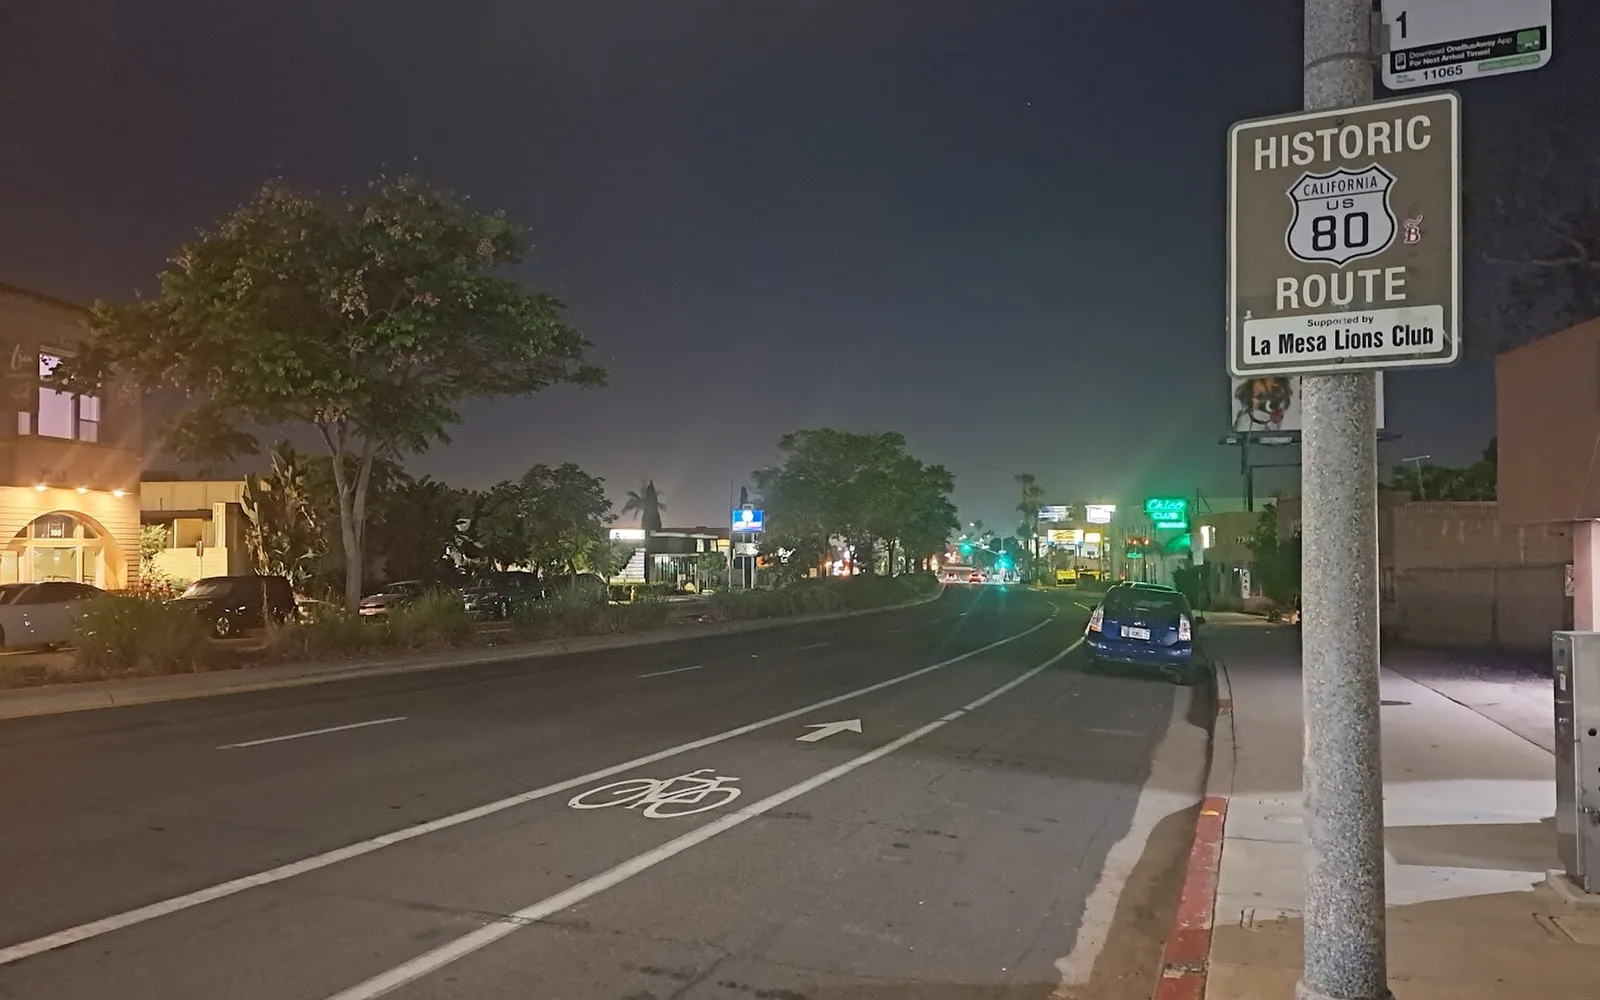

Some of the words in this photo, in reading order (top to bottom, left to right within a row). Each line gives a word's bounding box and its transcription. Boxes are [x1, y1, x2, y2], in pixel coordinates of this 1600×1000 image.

[1396, 11, 1407, 39] 1
[1409, 47, 1446, 60] Download
[1497, 37, 1513, 46] App
[1409, 59, 1422, 67] For
[1423, 56, 1441, 65] Next
[1441, 53, 1466, 62] Arrival
[1423, 65, 1463, 80] 11065
[1254, 115, 1431, 171] HISTORIC
[1303, 176, 1378, 196] CALIFORNIA
[1326, 198, 1354, 211] US
[1312, 211, 1369, 252] 80
[1276, 266, 1407, 311] ROUTE
[1307, 316, 1359, 327] Supported
[1362, 315, 1374, 325] by
[1251, 336, 1271, 356] La
[1278, 333, 1327, 354] Mesa
[1335, 329, 1384, 350] Lions
[1392, 324, 1434, 347] Club
